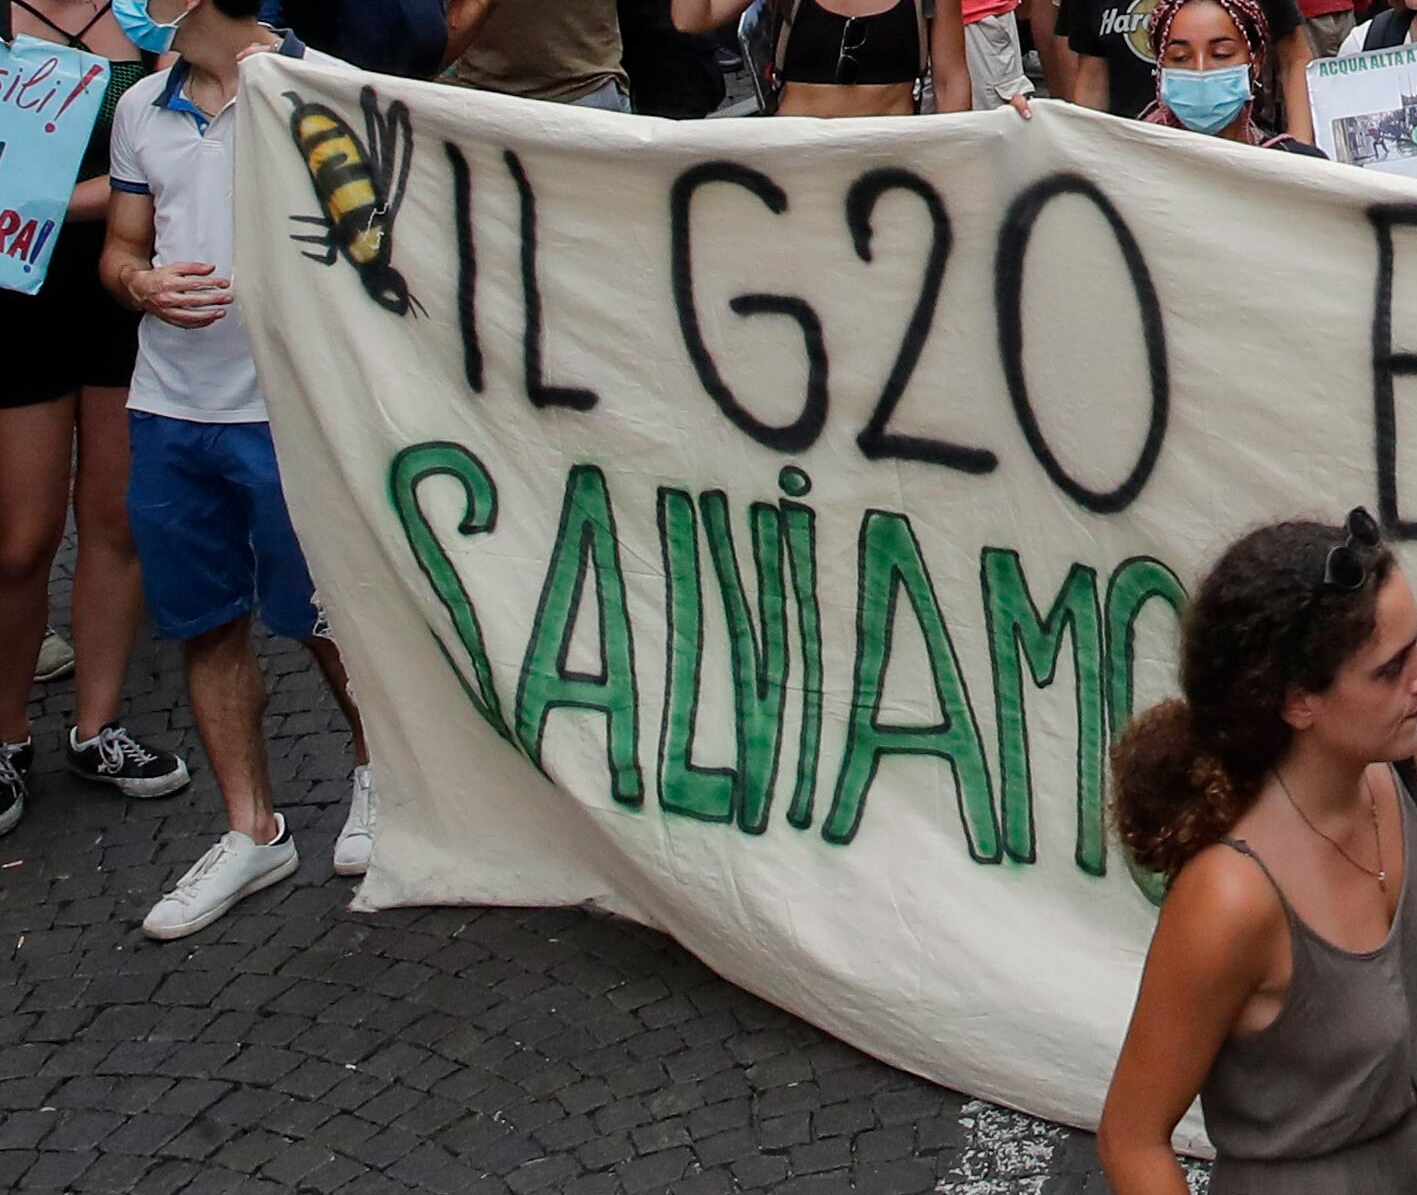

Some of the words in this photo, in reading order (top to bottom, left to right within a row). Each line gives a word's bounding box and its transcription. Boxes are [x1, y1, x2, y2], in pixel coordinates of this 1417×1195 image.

[1318, 56, 1368, 77] ACQUA
[1369, 51, 1405, 71] ALTA
[1404, 49, 1417, 64] A
[446, 139, 600, 411] IL
[668, 158, 1171, 516] G20
